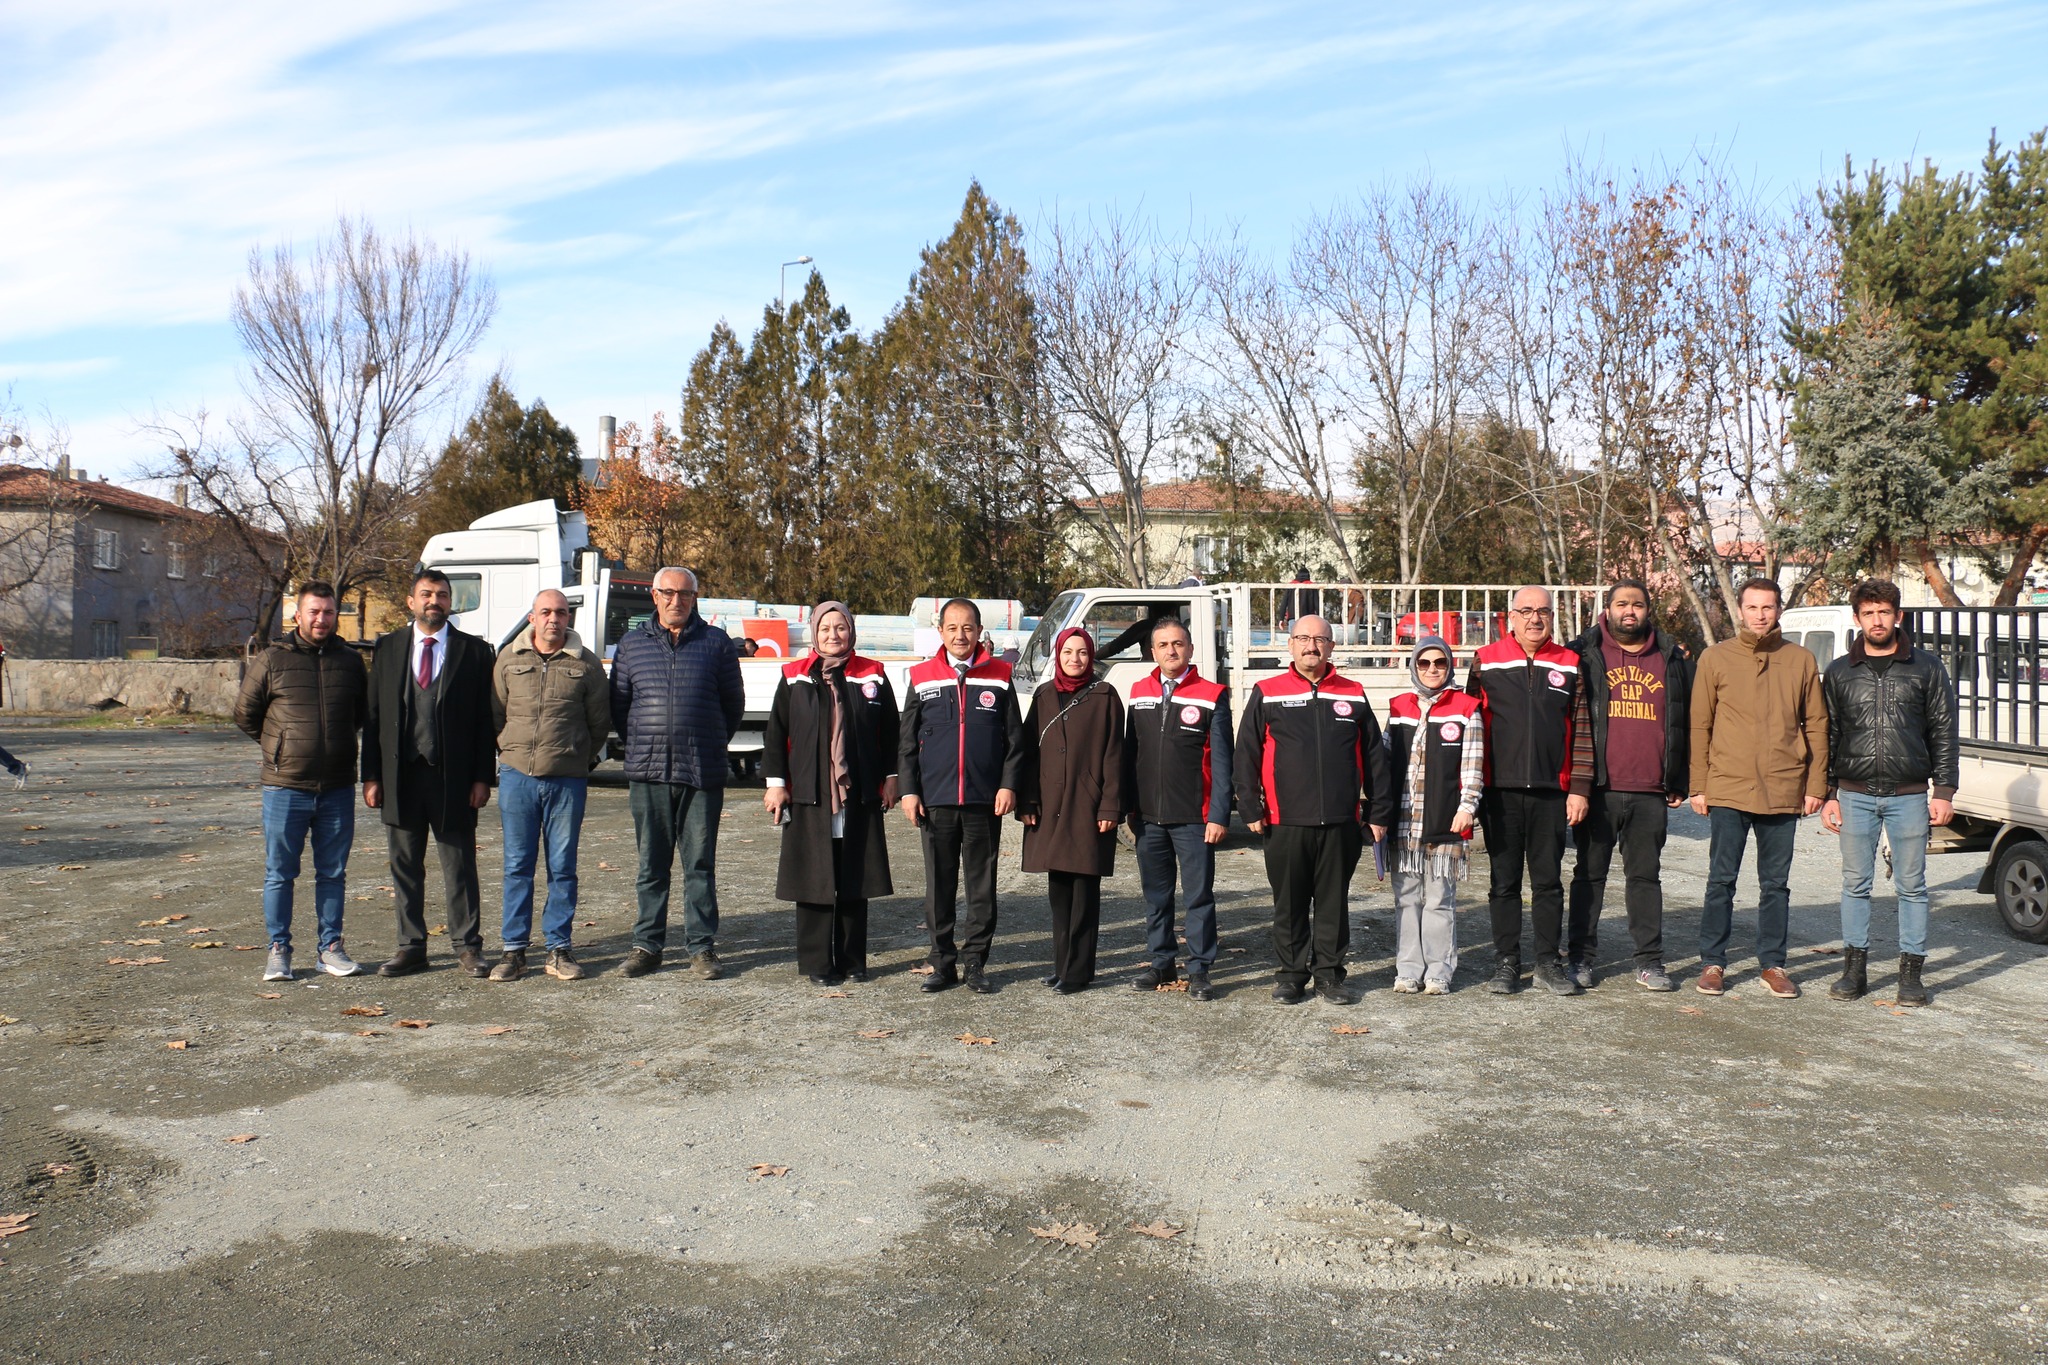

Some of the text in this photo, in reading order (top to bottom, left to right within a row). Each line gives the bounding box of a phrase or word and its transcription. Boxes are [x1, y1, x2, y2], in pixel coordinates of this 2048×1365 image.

[1628, 665, 1664, 693] YORK
[1621, 684, 1643, 700] GAP
[1608, 700, 1657, 721] ORIGINAL
